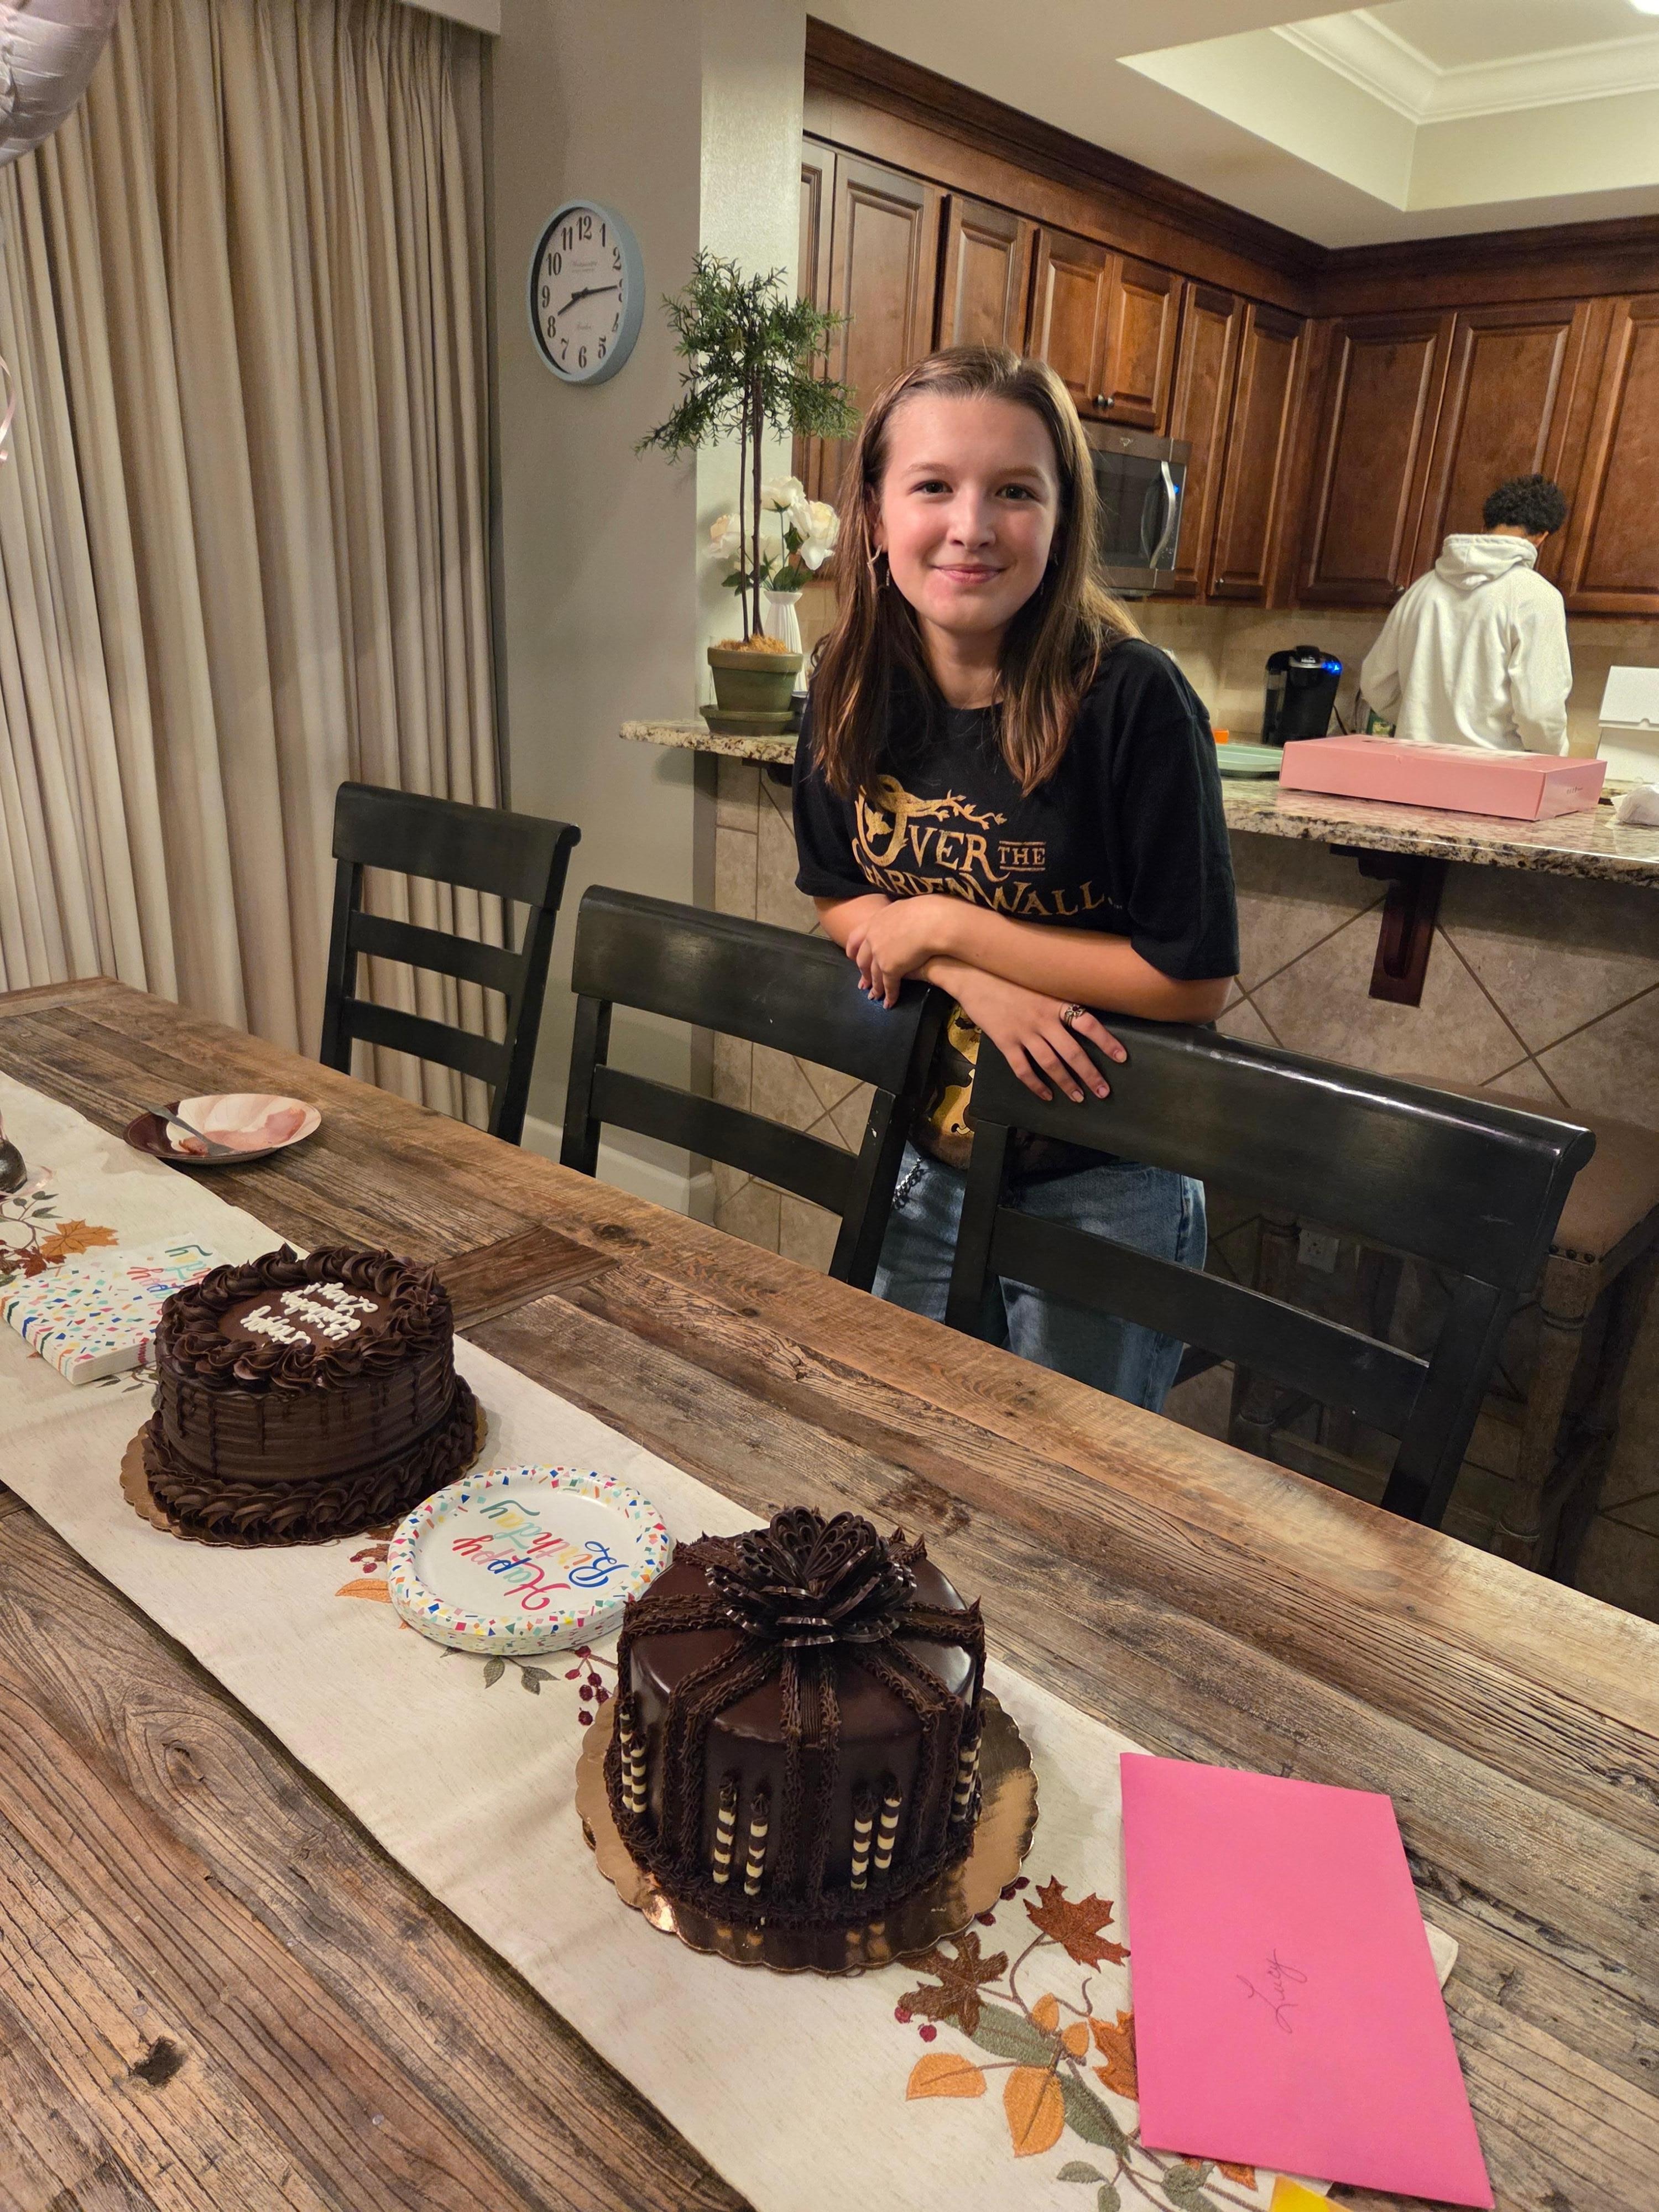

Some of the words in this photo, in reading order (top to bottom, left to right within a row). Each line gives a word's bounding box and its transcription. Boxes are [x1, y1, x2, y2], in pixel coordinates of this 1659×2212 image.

[561, 227, 573, 251] 11
[577, 215, 592, 241] 12
[599, 223, 606, 247] 1
[546, 252, 562, 276] 10
[612, 247, 622, 271] 2
[542, 285, 550, 309] 9
[547, 315, 556, 338] 8
[561, 338, 570, 361] 7
[578, 346, 587, 369] 6
[598, 335, 607, 359] 5
[998, 846, 1045, 865] THE
[479, 1499, 630, 1588] Birthday
[452, 1534, 571, 1610] Happy
[1236, 1948, 1308, 2033] Lucy
